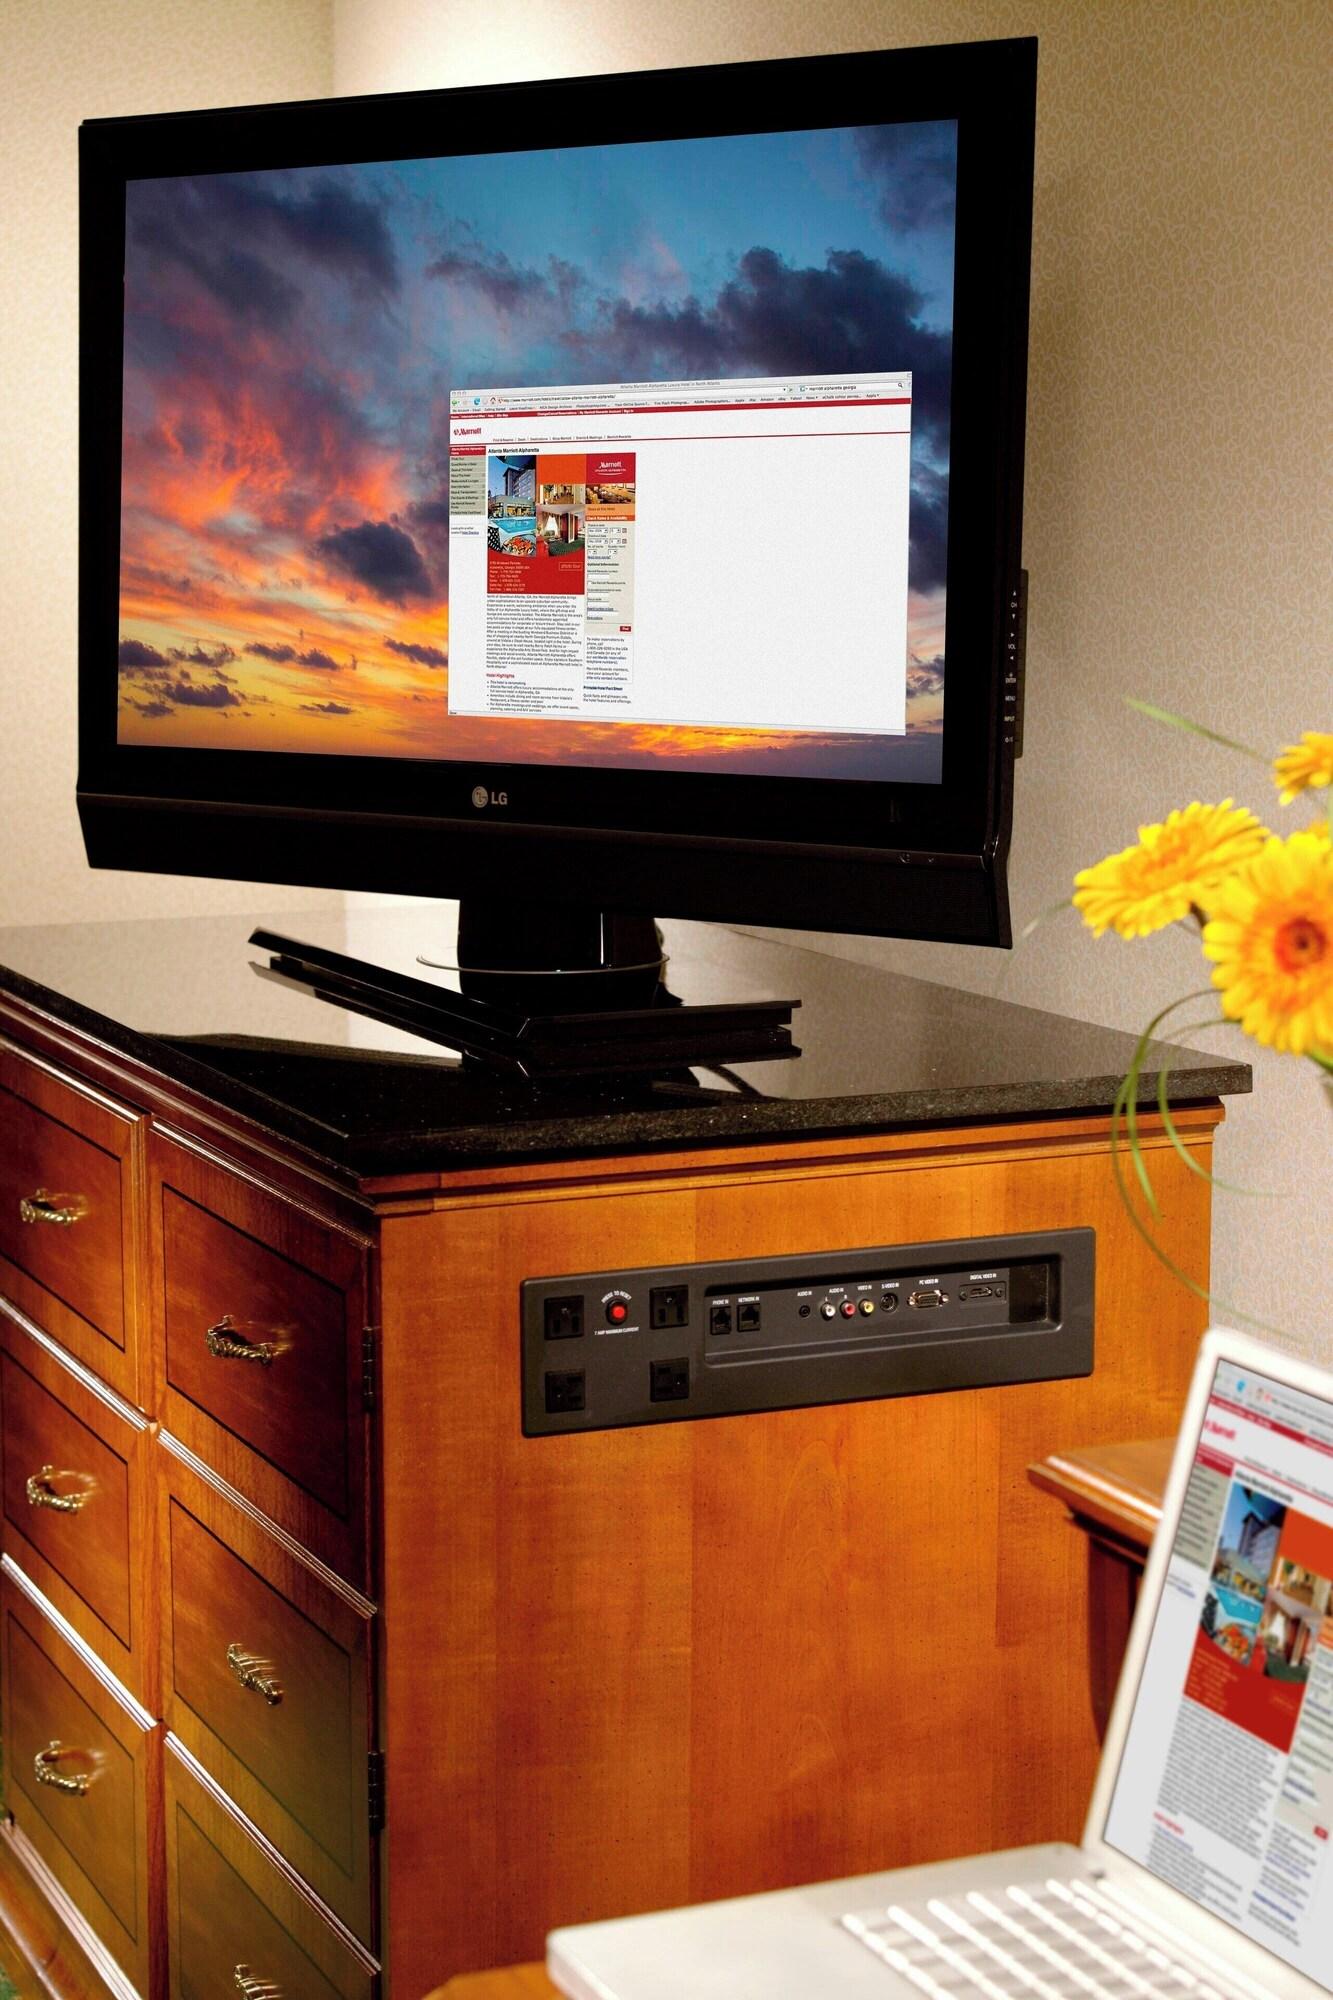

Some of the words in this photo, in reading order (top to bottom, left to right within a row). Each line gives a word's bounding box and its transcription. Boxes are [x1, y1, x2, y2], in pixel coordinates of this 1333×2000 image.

[491, 791, 508, 806] LG
[620, 1291, 632, 1300] RESET
[623, 1326, 640, 1334] CURRENT
